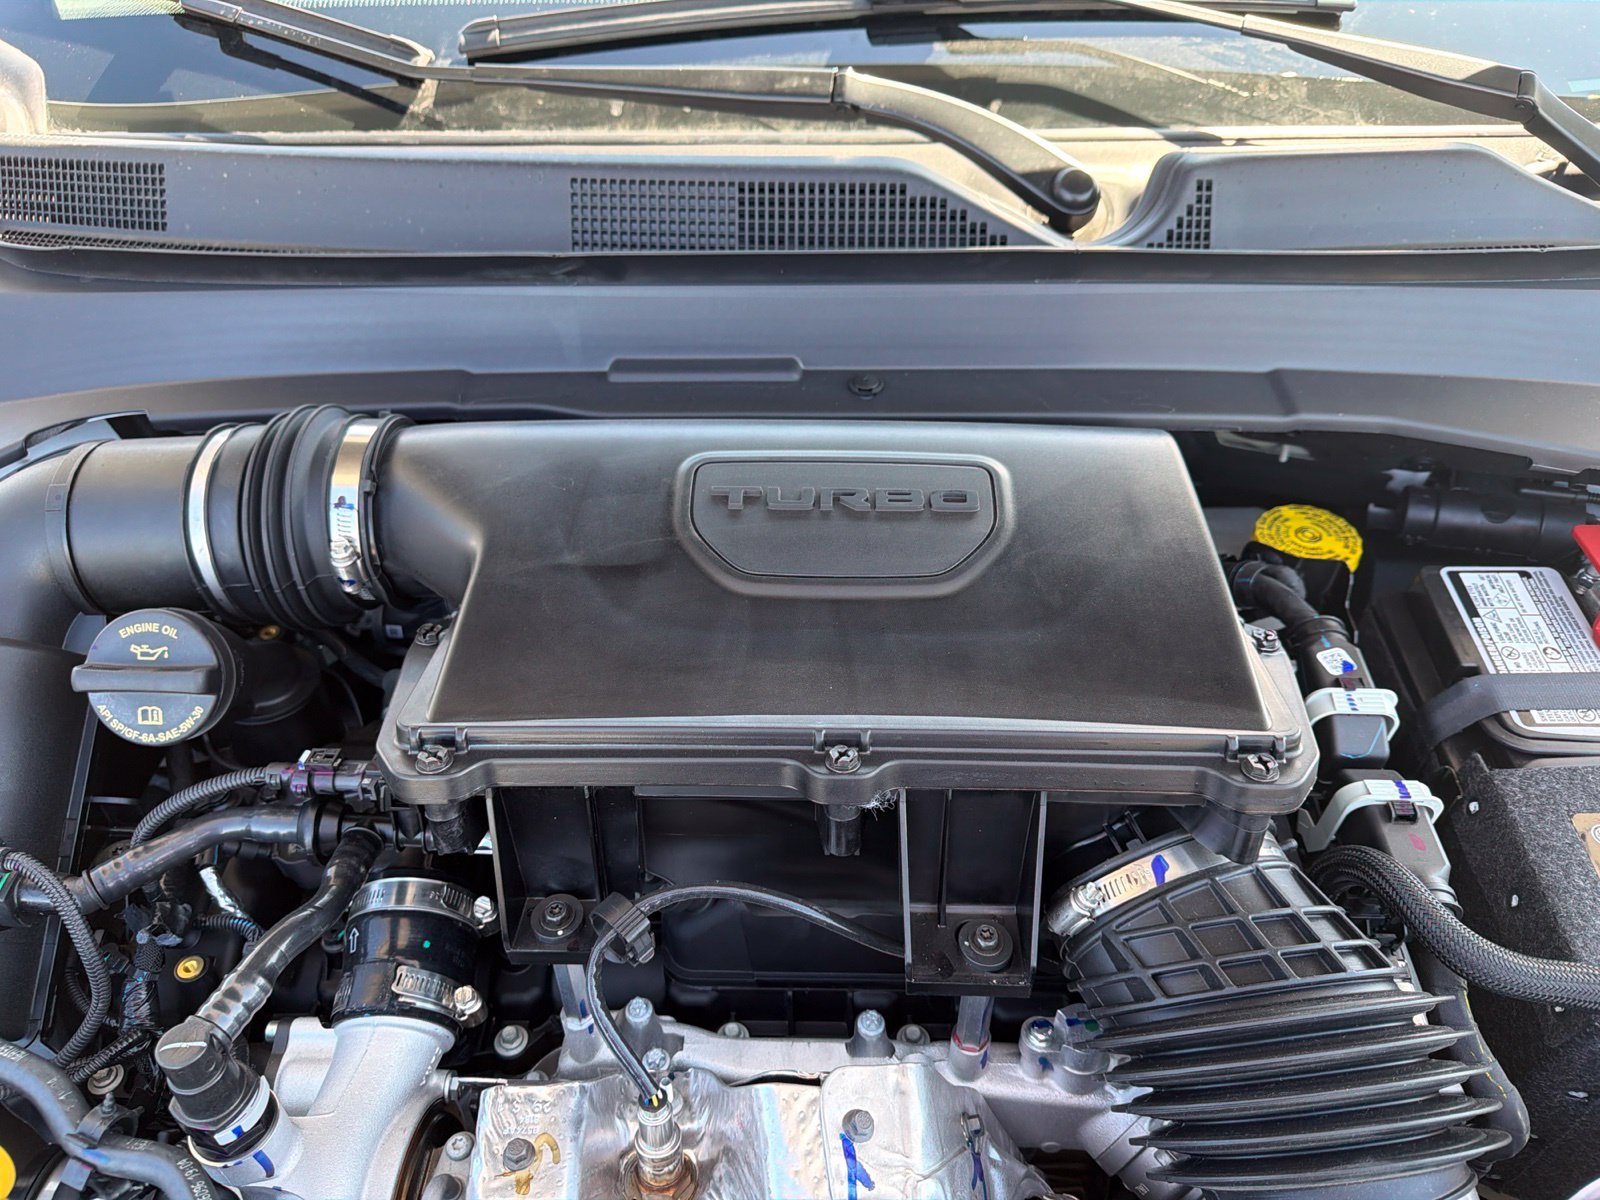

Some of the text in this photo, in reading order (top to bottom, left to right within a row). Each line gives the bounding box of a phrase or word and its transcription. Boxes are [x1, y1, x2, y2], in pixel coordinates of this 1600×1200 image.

[711, 485, 980, 512] TURBO
[118, 623, 178, 639] ENGINE OIL
[97, 704, 204, 743] API SP/GF-6A-SAE-5W-30
